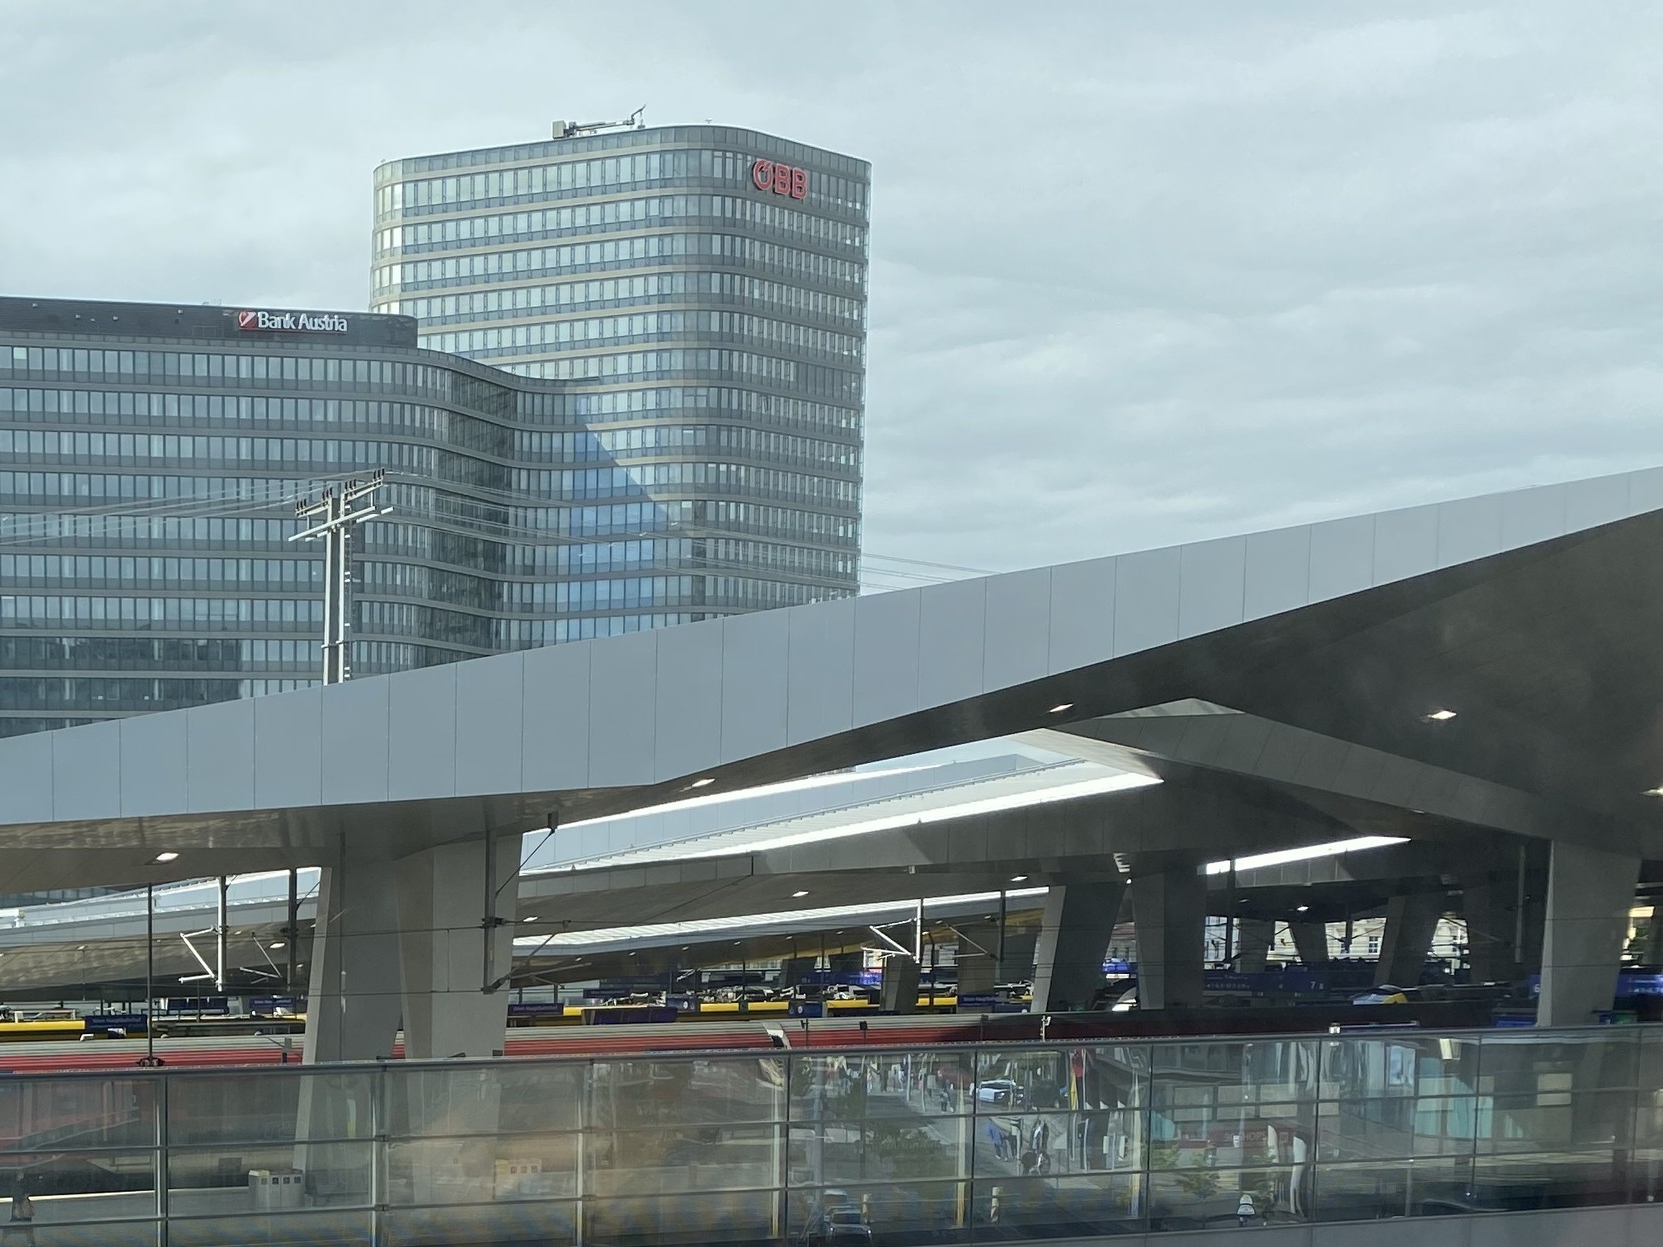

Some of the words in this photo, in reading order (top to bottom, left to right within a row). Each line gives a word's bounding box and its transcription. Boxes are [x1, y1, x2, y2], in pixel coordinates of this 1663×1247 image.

[753, 158, 807, 199] ÖBB
[258, 311, 296, 329] Bank
[298, 313, 347, 331] Austria
